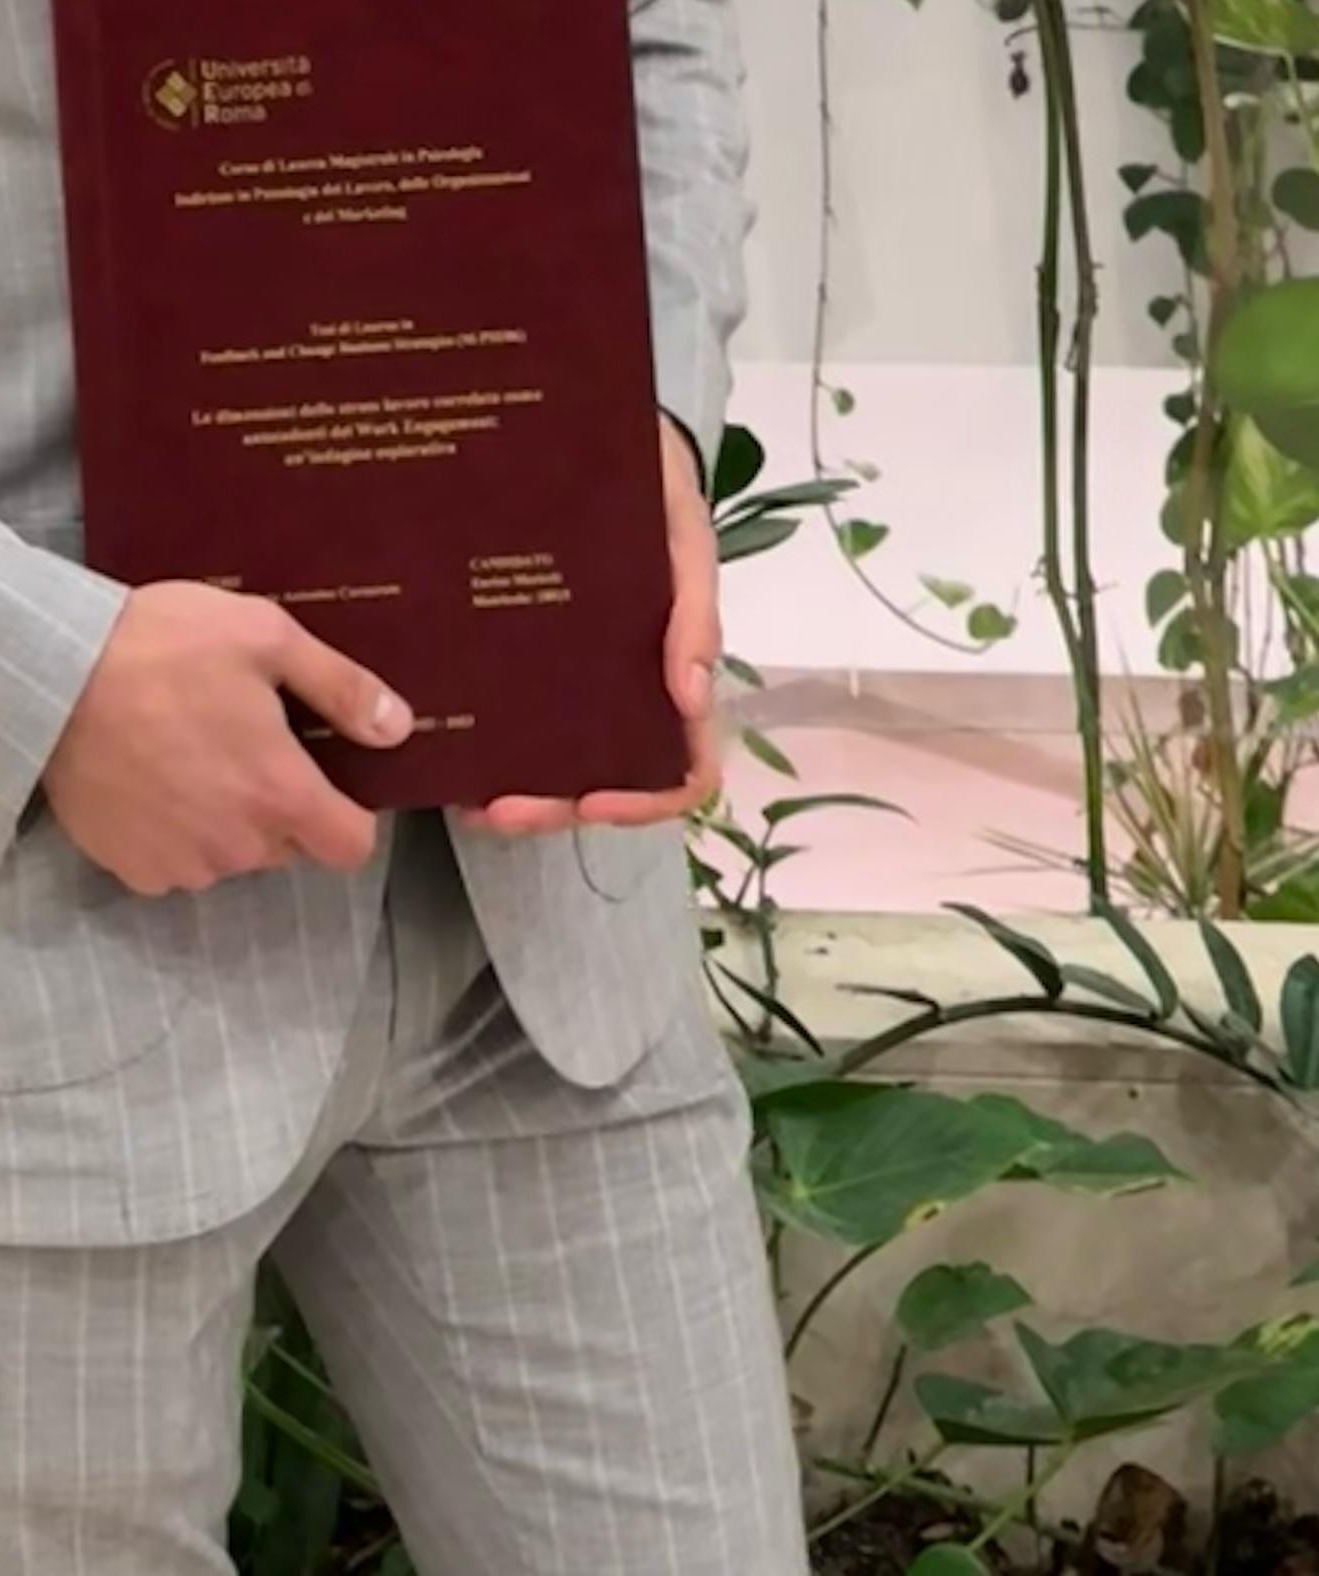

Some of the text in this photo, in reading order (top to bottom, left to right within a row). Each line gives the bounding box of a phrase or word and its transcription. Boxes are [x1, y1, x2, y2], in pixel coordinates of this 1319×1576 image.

[200, 55, 312, 79] Università
[202, 81, 293, 102] Europea
[203, 103, 267, 124] Roma
